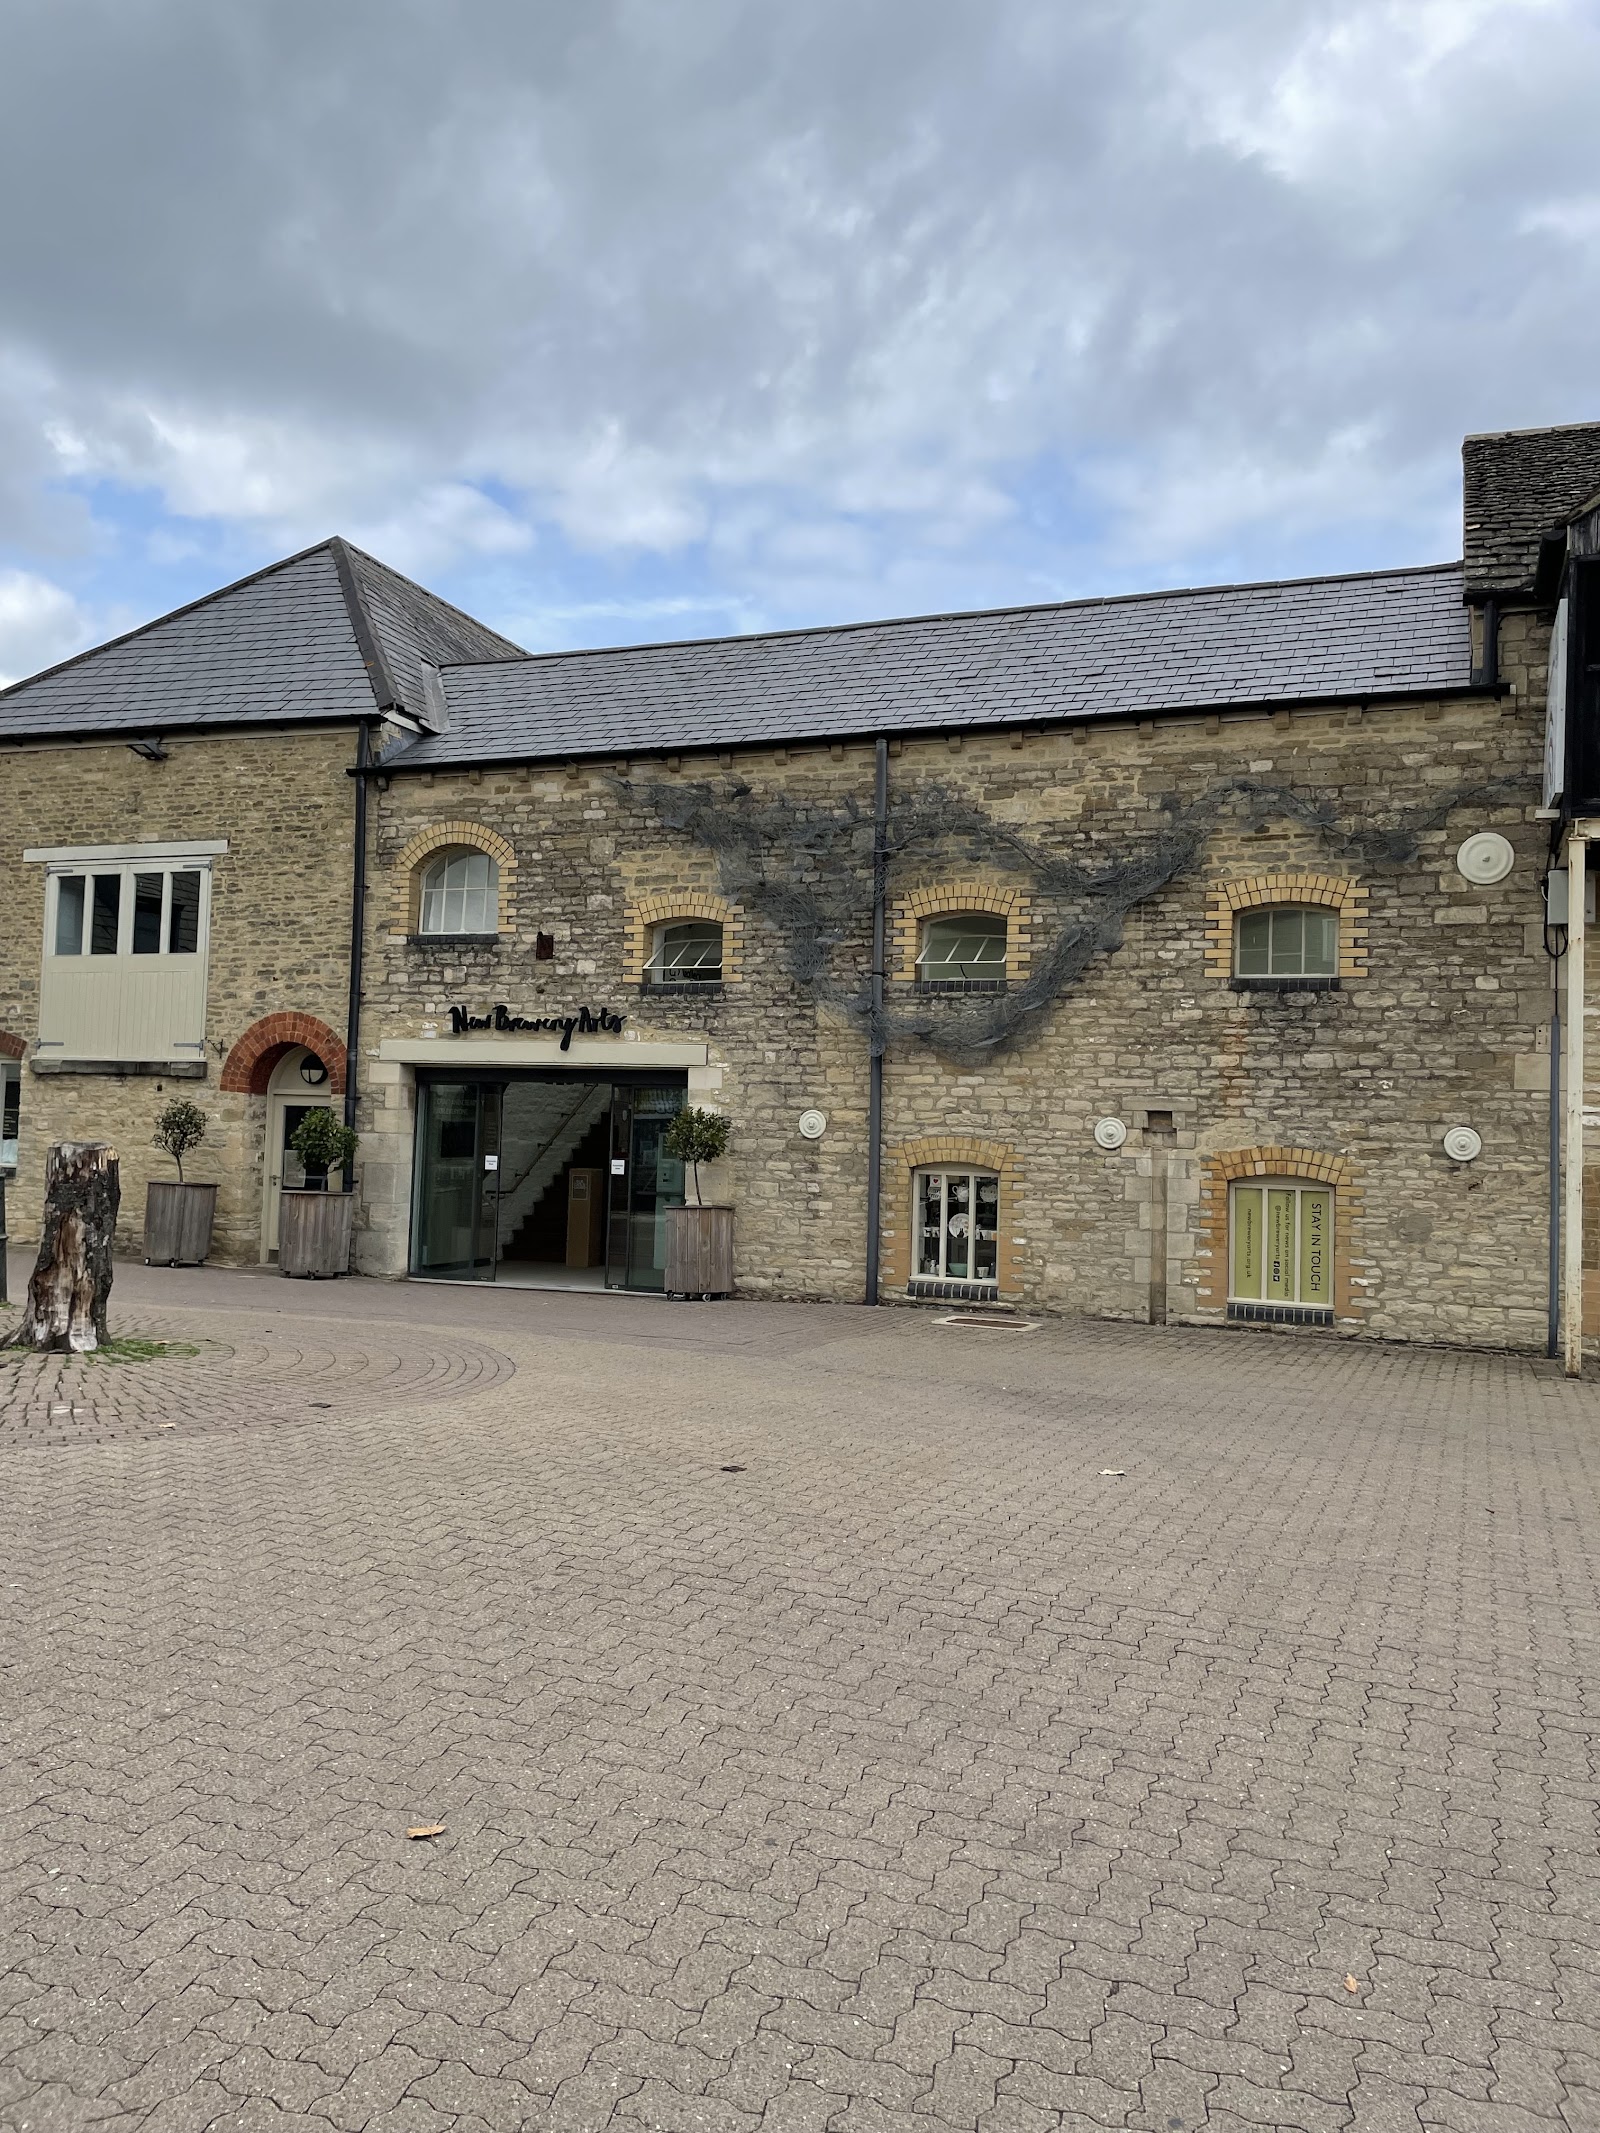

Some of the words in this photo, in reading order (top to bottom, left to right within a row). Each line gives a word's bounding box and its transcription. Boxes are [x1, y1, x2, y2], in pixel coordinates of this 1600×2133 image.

[448, 1005, 492, 1034] New
[492, 1005, 578, 1051] Brewery
[579, 1006, 627, 1033] Arts
[1312, 1203, 1321, 1230] STAY
[1311, 1234, 1321, 1246] IN
[1311, 1250, 1320, 1291] TOUCH
